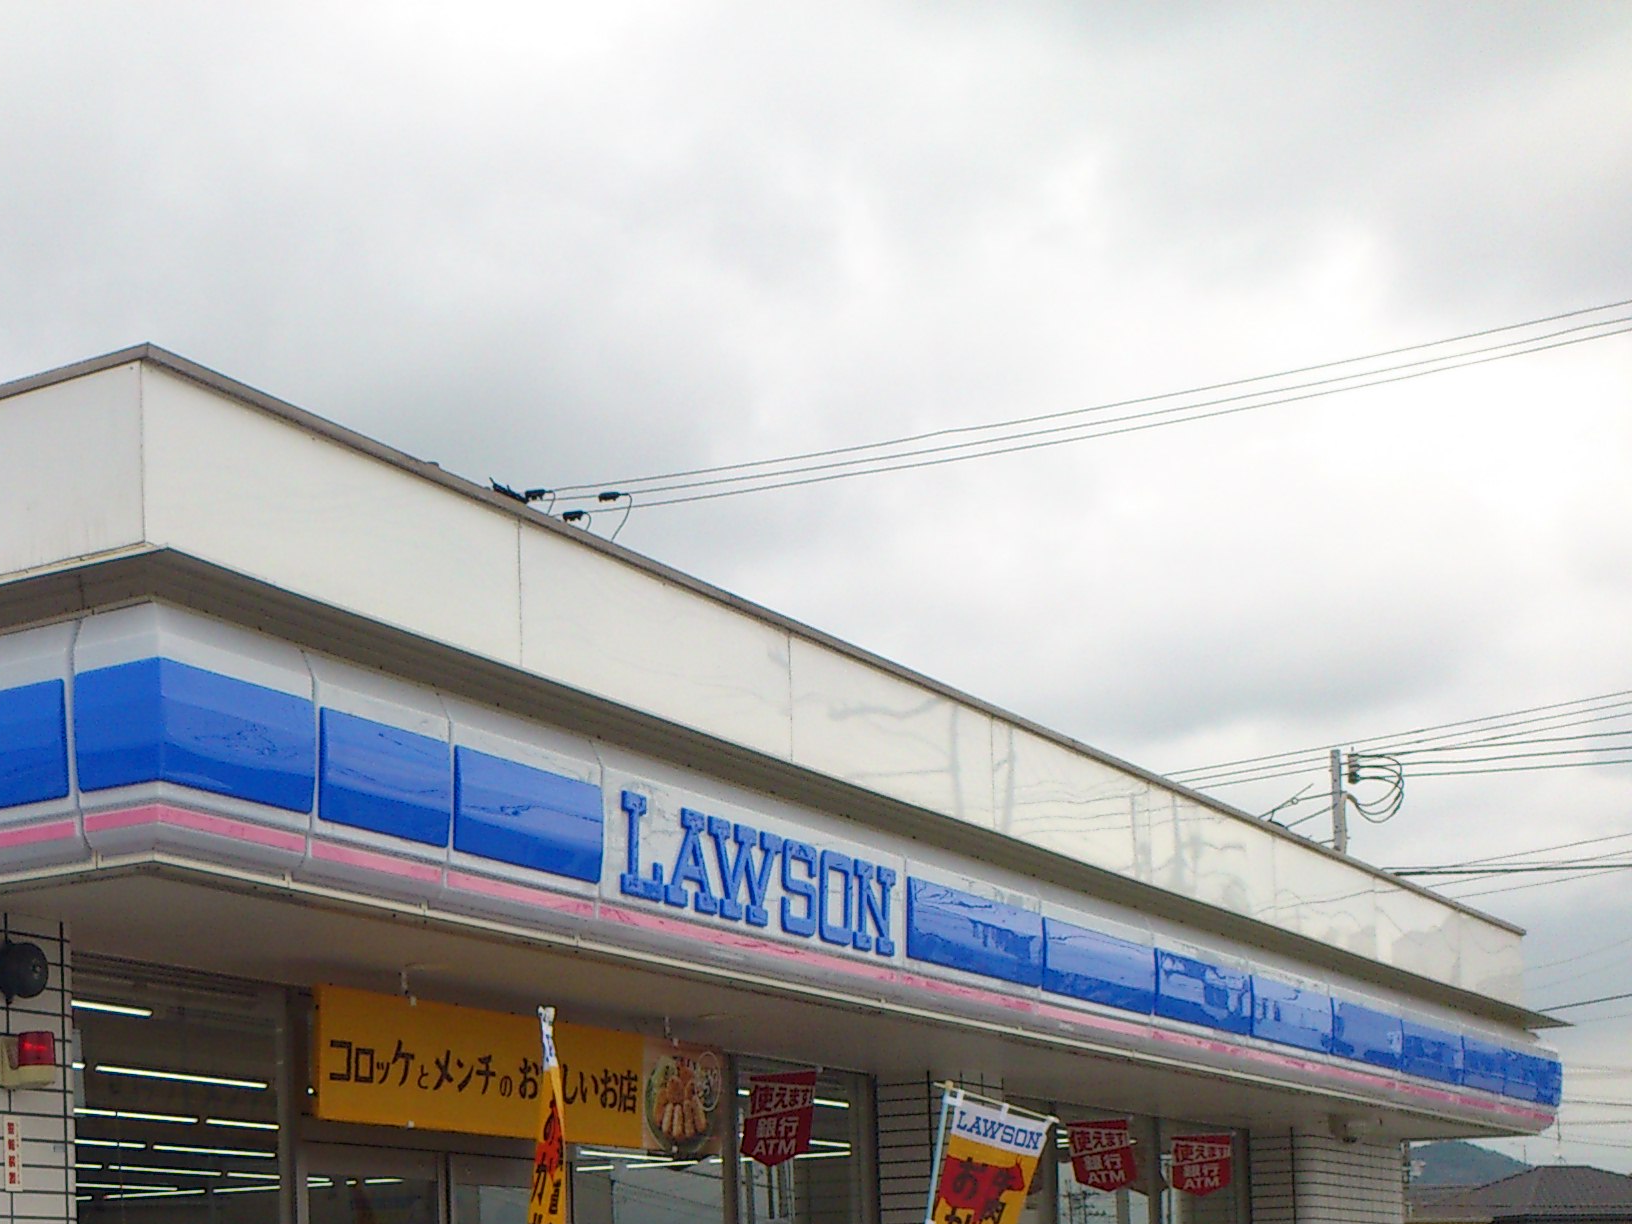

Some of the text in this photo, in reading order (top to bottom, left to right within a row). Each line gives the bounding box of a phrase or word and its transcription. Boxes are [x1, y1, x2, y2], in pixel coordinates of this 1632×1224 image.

[620, 789, 896, 957] LAWSON
[329, 1038, 639, 1114] コロッケとメンチのおしいお店
[756, 1116, 799, 1138] 銀行
[956, 1110, 1043, 1151] LAWSON
[752, 1138, 797, 1155] ATM
[1083, 1153, 1122, 1171] 銀行
[1087, 1170, 1126, 1184] ATM
[1184, 1177, 1219, 1190] ATM
